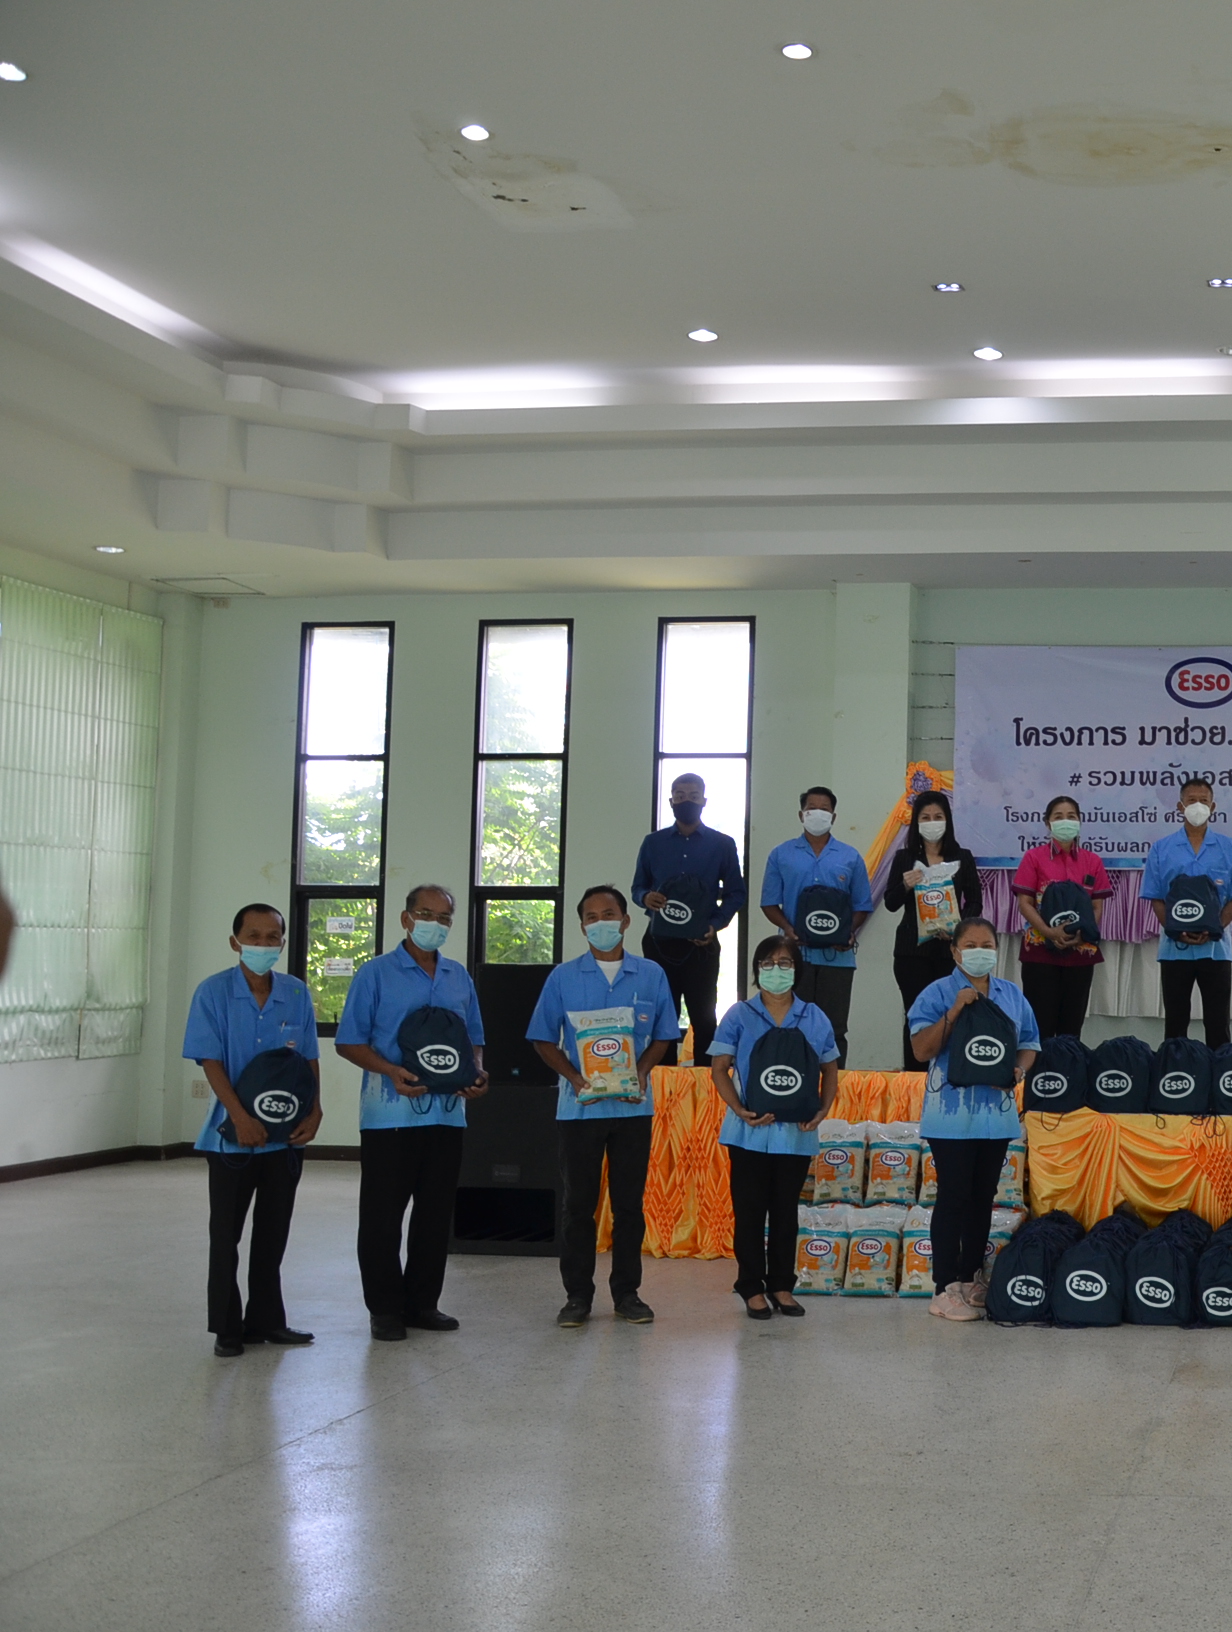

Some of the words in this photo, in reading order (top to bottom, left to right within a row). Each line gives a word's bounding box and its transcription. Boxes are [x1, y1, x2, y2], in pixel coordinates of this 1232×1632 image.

[1178, 669, 1230, 692] Esso
[1012, 717, 1127, 747] โครงการ
[925, 894, 941, 902] Esso
[665, 905, 687, 918] Esso
[1177, 905, 1199, 915] Esso
[810, 916, 834, 928] Esso
[596, 1043, 617, 1052] Esso
[971, 1043, 999, 1057] Esso
[767, 1072, 796, 1086] Esso
[1037, 1079, 1062, 1090] Esso
[1101, 1077, 1127, 1088] Esso
[1165, 1079, 1189, 1090] Esso
[884, 1154, 902, 1162] Esso
[809, 1242, 828, 1251] Esso
[861, 1242, 878, 1250] Esso
[1014, 1281, 1042, 1298] Esso
[1072, 1277, 1101, 1293] Esso
[1141, 1282, 1169, 1301] Esso
